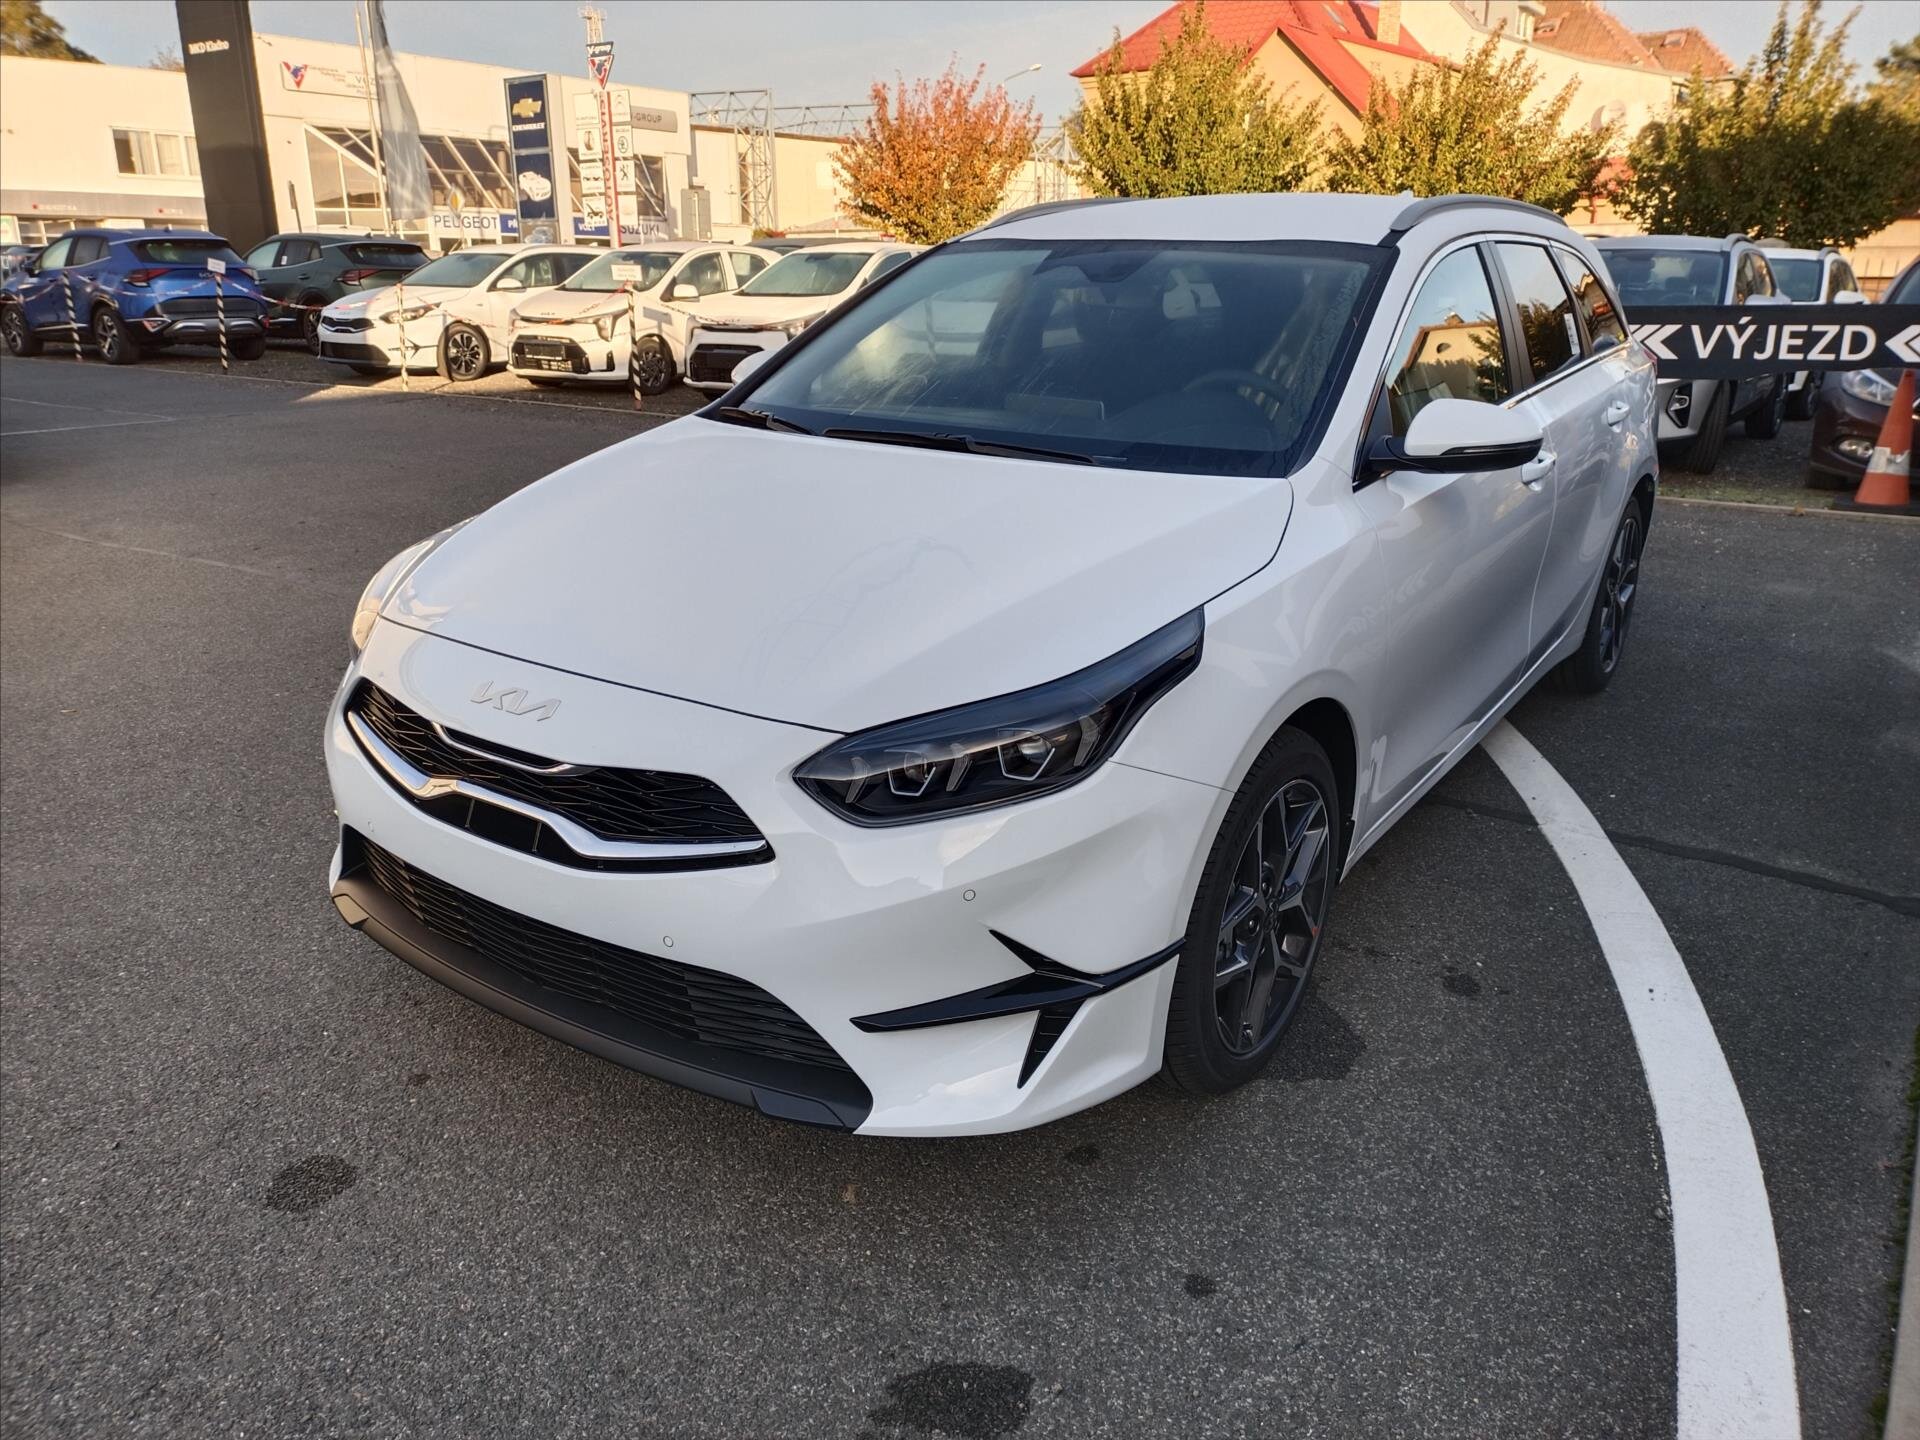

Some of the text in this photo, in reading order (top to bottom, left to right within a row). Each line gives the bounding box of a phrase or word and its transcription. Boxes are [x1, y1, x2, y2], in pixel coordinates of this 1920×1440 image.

[433, 214, 498, 229] PEUGEOT
[620, 223, 660, 236] SUZUKI
[1689, 316, 1878, 362] VÝJEZD
[470, 680, 562, 722] KIA
